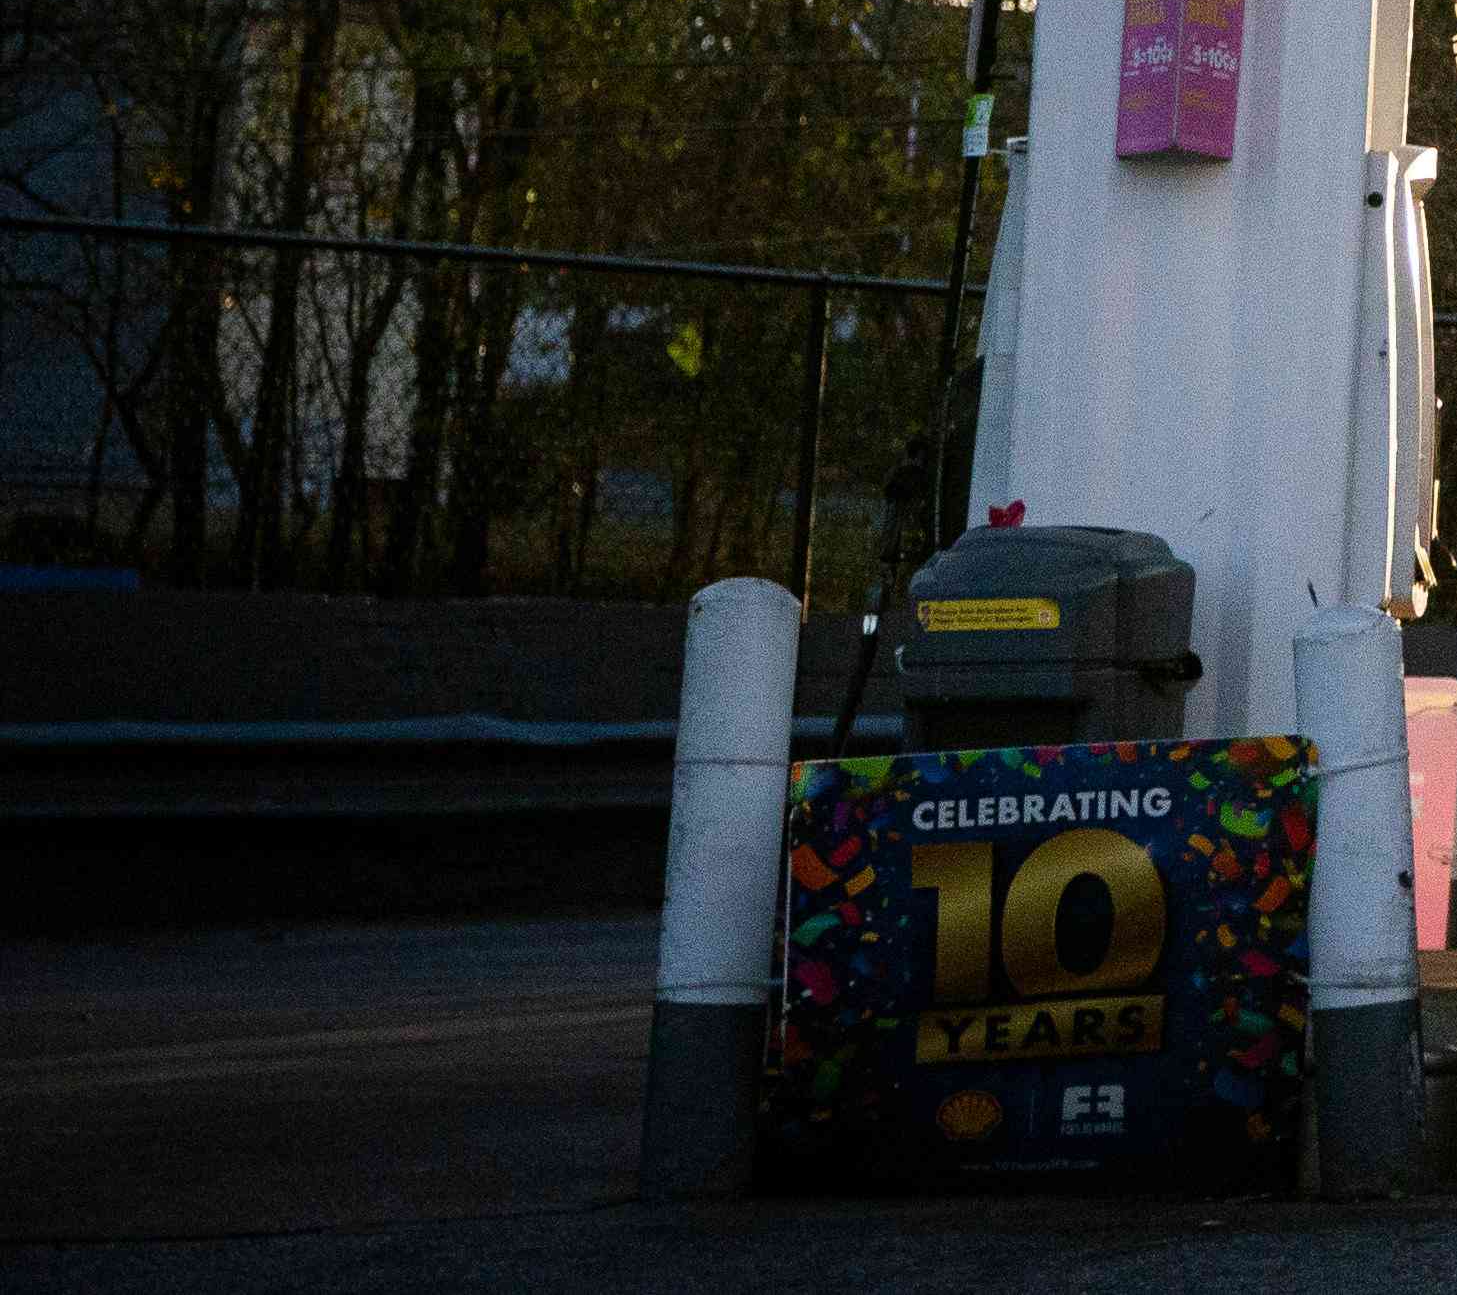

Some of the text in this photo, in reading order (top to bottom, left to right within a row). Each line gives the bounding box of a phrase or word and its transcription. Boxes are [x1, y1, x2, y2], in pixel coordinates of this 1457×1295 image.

[912, 786, 1172, 831] CELEBRATING
[911, 827, 1168, 1003] 10
[937, 1004, 1146, 1055] YEARS
